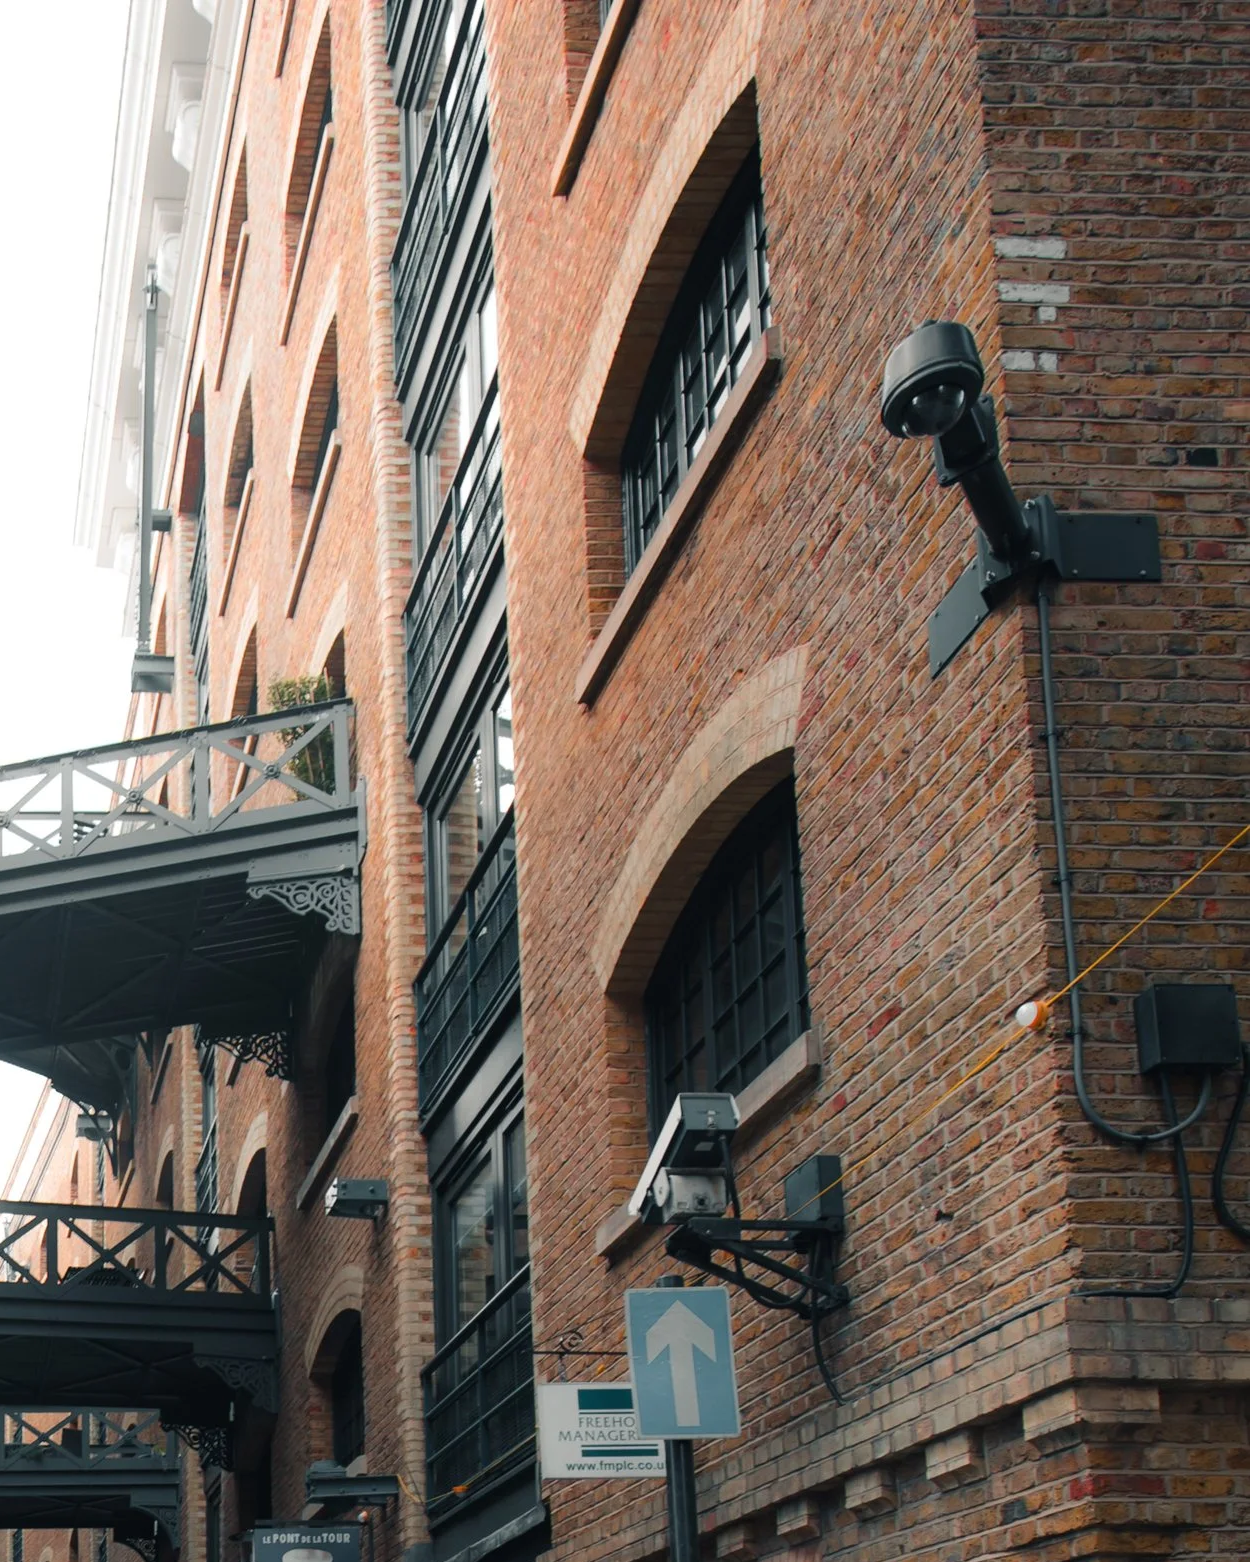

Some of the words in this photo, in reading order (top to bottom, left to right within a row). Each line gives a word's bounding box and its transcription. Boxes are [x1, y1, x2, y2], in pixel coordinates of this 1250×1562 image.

[578, 1416, 636, 1428] FREEHO
[558, 1430, 639, 1442] MANAGER
[565, 1460, 665, 1473] www.fmplc.co.u
[262, 1535, 271, 1544] LE
[272, 1533, 301, 1544] PONT
[301, 1535, 310, 1544] DE
[312, 1535, 321, 1544] LA
[321, 1532, 351, 1544] TOUR
